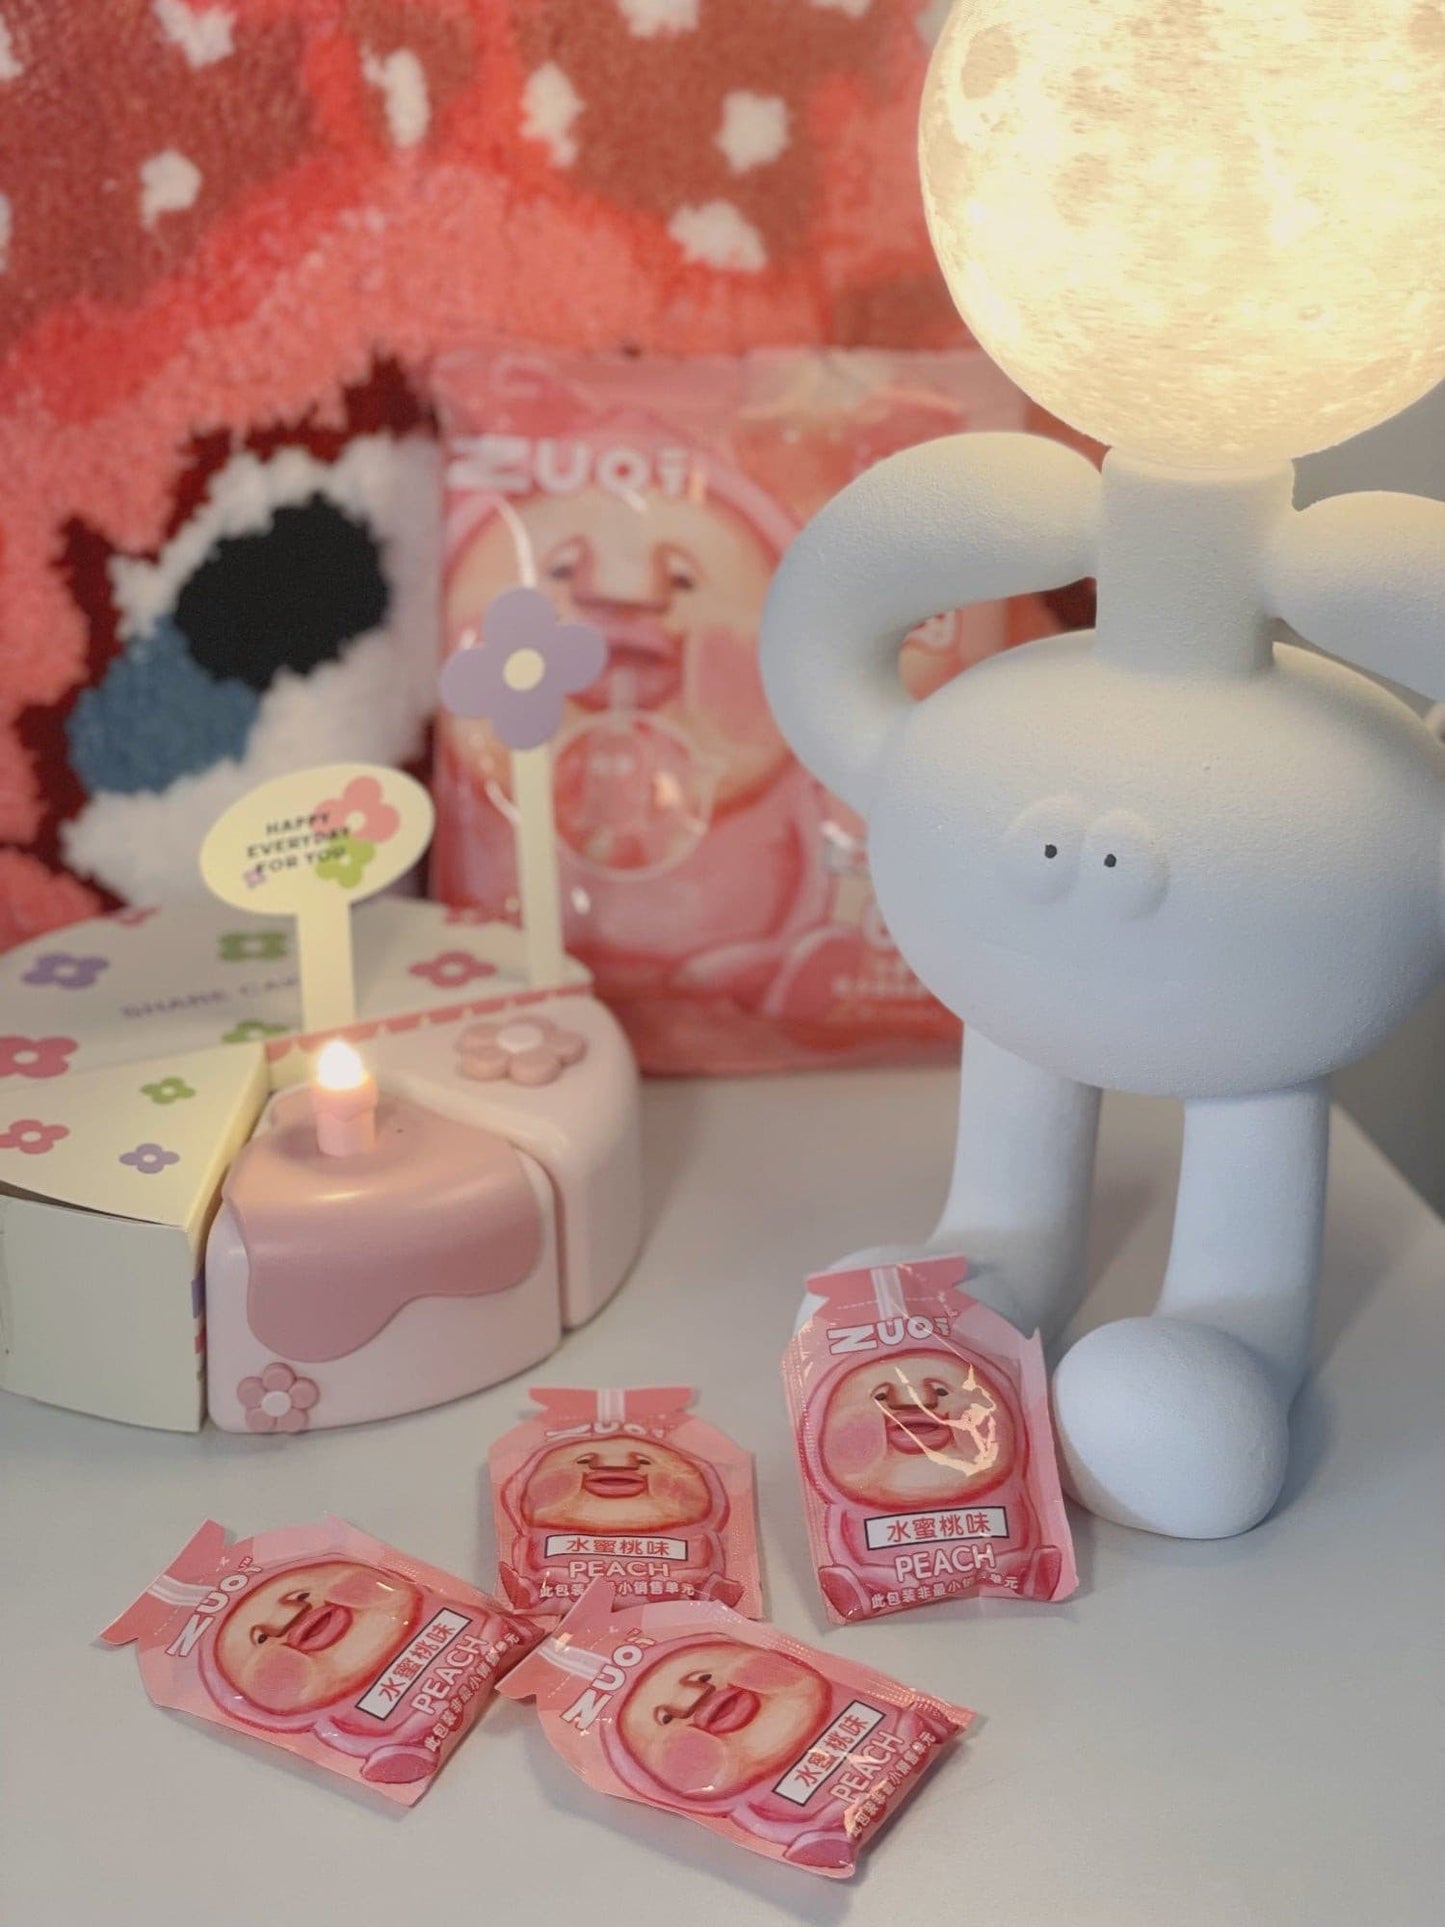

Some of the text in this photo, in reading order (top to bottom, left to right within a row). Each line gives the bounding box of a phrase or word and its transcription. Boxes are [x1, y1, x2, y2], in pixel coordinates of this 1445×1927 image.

[265, 812, 331, 835] HAPPY
[247, 826, 350, 858] EVERYDAY
[255, 847, 347, 874] FOR YOU
[887, 1511, 992, 1543] 水蜜桃味
[567, 1537, 671, 1556] 水蜜桃味
[568, 1560, 671, 1579] PEACH
[895, 1543, 997, 1583] PEACH
[378, 1622, 456, 1703] 水蜜桃味
[410, 1634, 489, 1717] PEACH
[794, 1714, 869, 1788] 水蜜桃味
[829, 1730, 905, 1804] PEACH
